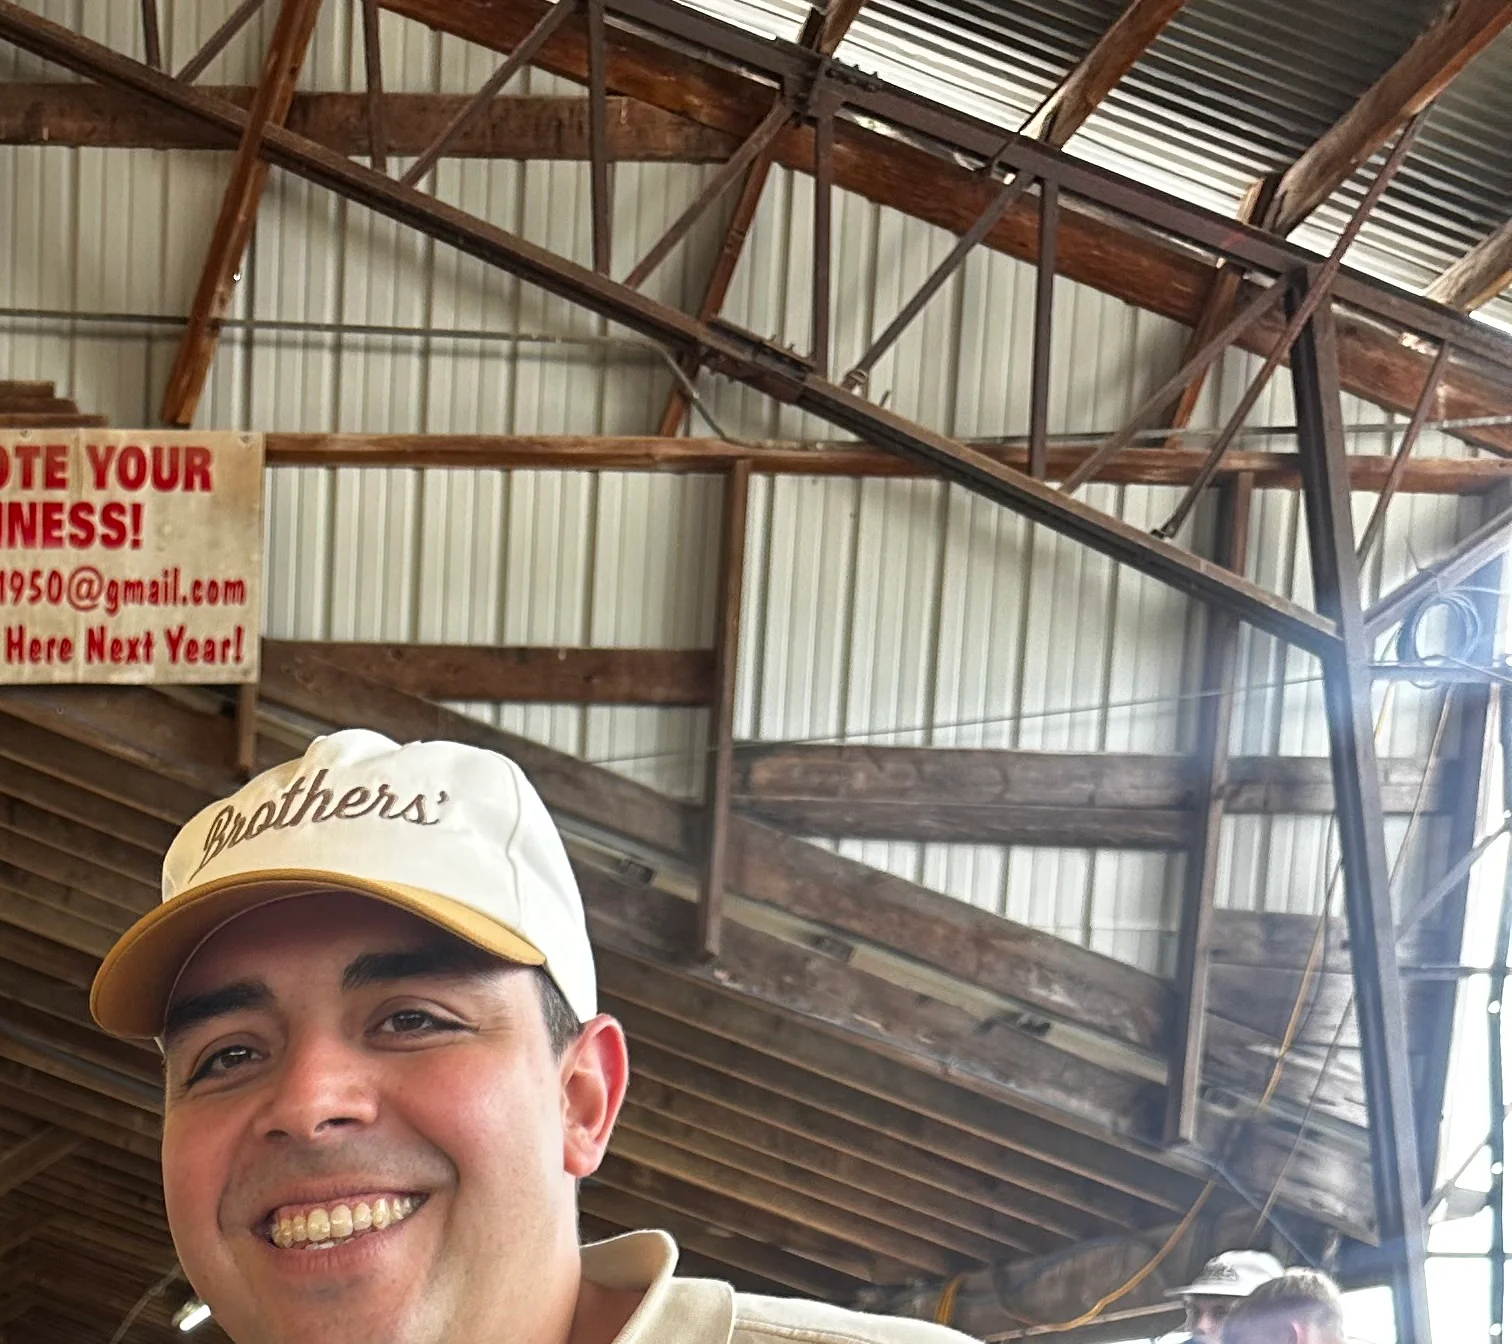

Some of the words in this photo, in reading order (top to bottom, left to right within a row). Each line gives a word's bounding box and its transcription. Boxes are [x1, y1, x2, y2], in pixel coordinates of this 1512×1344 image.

[85, 445, 212, 492] YOUR
[4, 625, 74, 664] Here
[87, 625, 155, 665] Next
[165, 625, 245, 665] Year!
[188, 769, 449, 883] Brothers'
